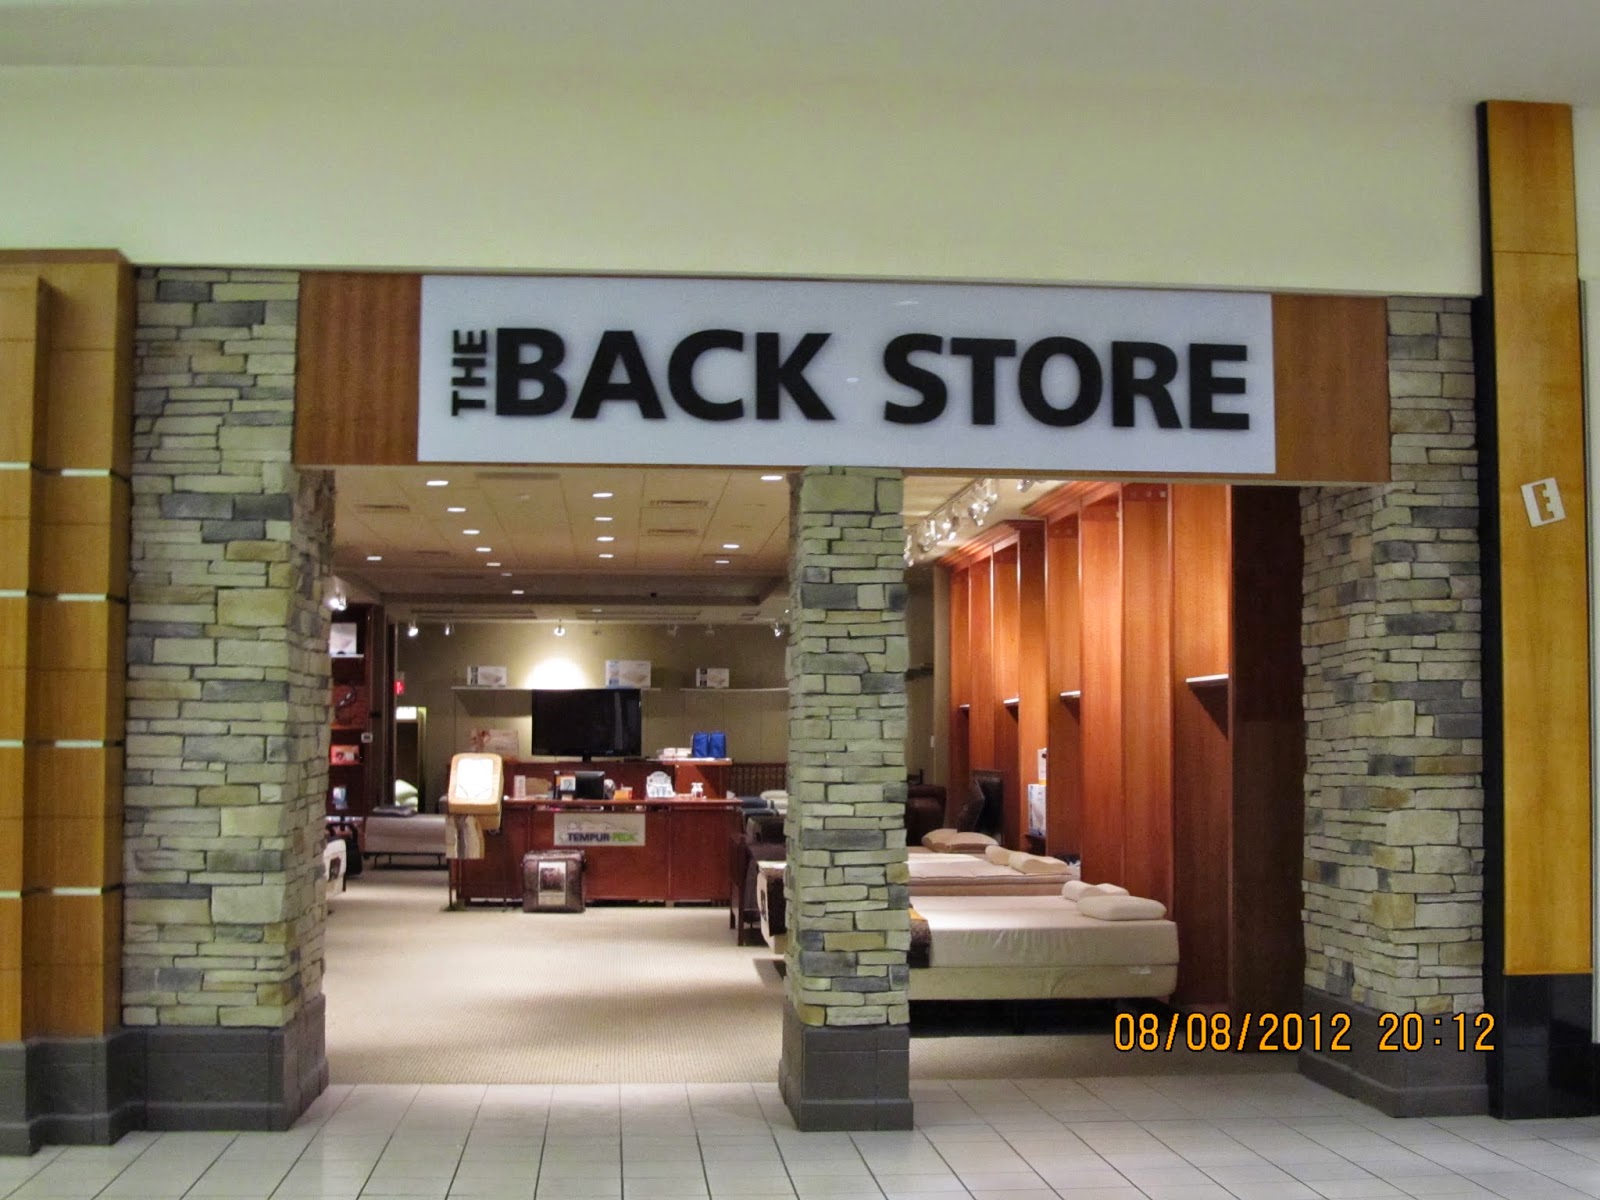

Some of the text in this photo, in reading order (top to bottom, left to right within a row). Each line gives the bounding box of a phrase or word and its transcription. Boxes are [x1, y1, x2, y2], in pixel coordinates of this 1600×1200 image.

[451, 327, 1250, 430] THE BACK STORE
